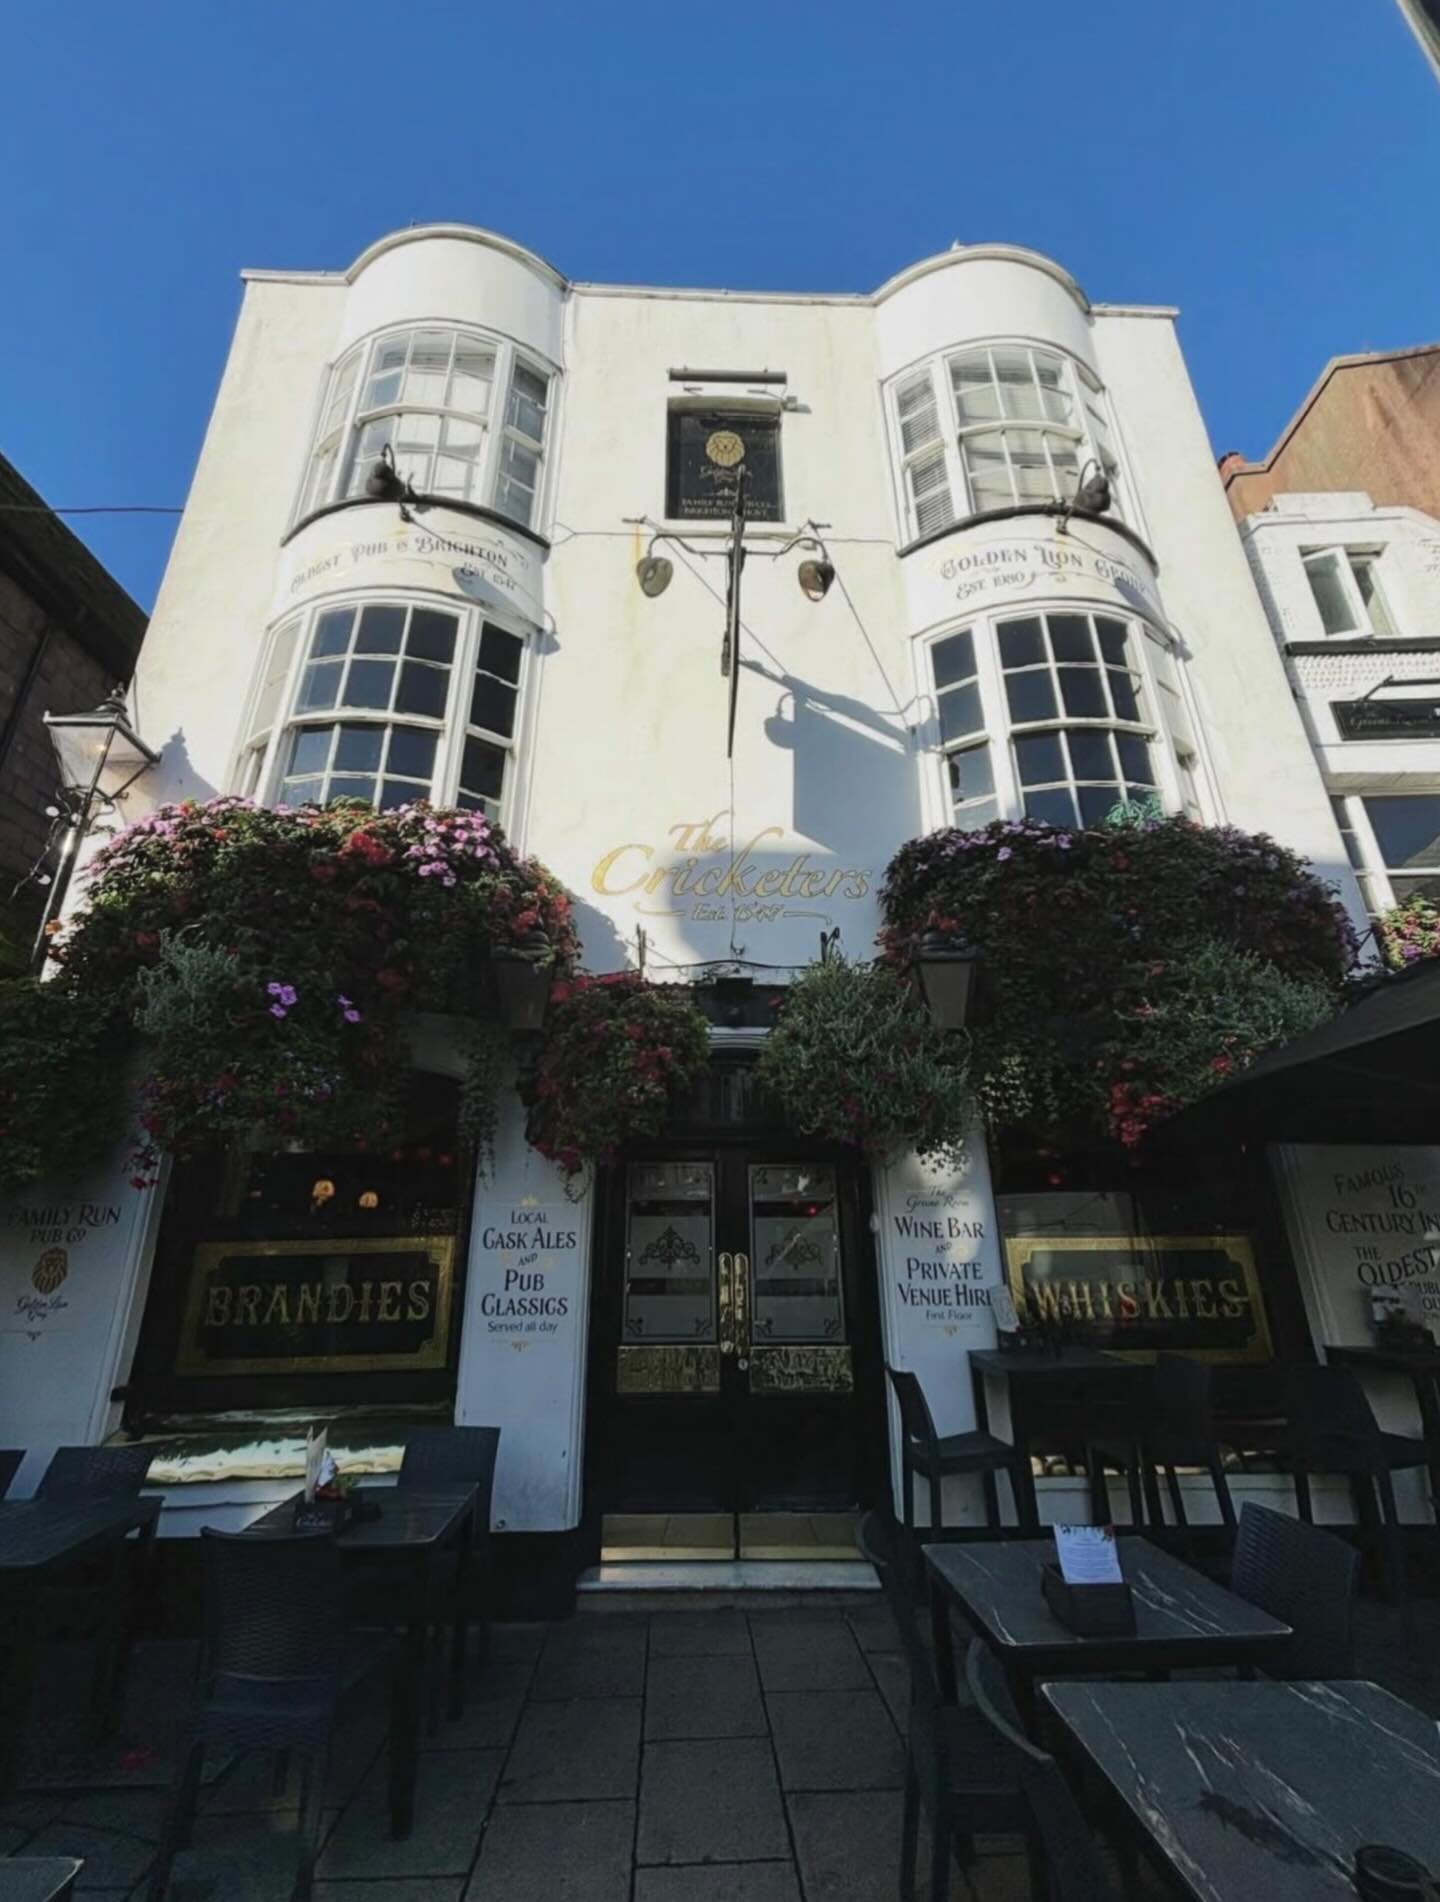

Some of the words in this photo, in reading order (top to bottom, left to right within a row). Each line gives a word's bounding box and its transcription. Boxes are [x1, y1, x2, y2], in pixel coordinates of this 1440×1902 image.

[414, 534, 508, 568] BRIGHTON
[940, 548, 1028, 580] GOLDEN
[1033, 544, 1083, 569] LION
[955, 579, 985, 600] EST
[668, 810, 734, 853] The
[591, 826, 872, 899] Cricketers
[1333, 1164, 1404, 1195] FAMOUS
[8, 1205, 73, 1227] FAMILY
[79, 1203, 122, 1228] RUN
[511, 1210, 548, 1225] LOCAL
[894, 1215, 944, 1239] WINE
[947, 1216, 985, 1239] BAR
[1326, 1209, 1416, 1235] CENTURY
[1418, 1209, 1440, 1234] IN
[482, 1227, 528, 1250] CASK
[531, 1227, 577, 1250] ALES
[517, 1252, 538, 1266] AND
[906, 1256, 984, 1281] PRIVATE
[1357, 1246, 1436, 1286] OLDEST
[504, 1268, 545, 1292] PUB
[204, 1280, 432, 1327] BRANDIES
[481, 1292, 569, 1317] CLASSICS
[898, 1282, 951, 1307] VENUE
[1030, 1279, 1249, 1321] WHISKIES
[487, 1320, 523, 1333] Served
[525, 1320, 537, 1331] all
[538, 1320, 559, 1335] day
